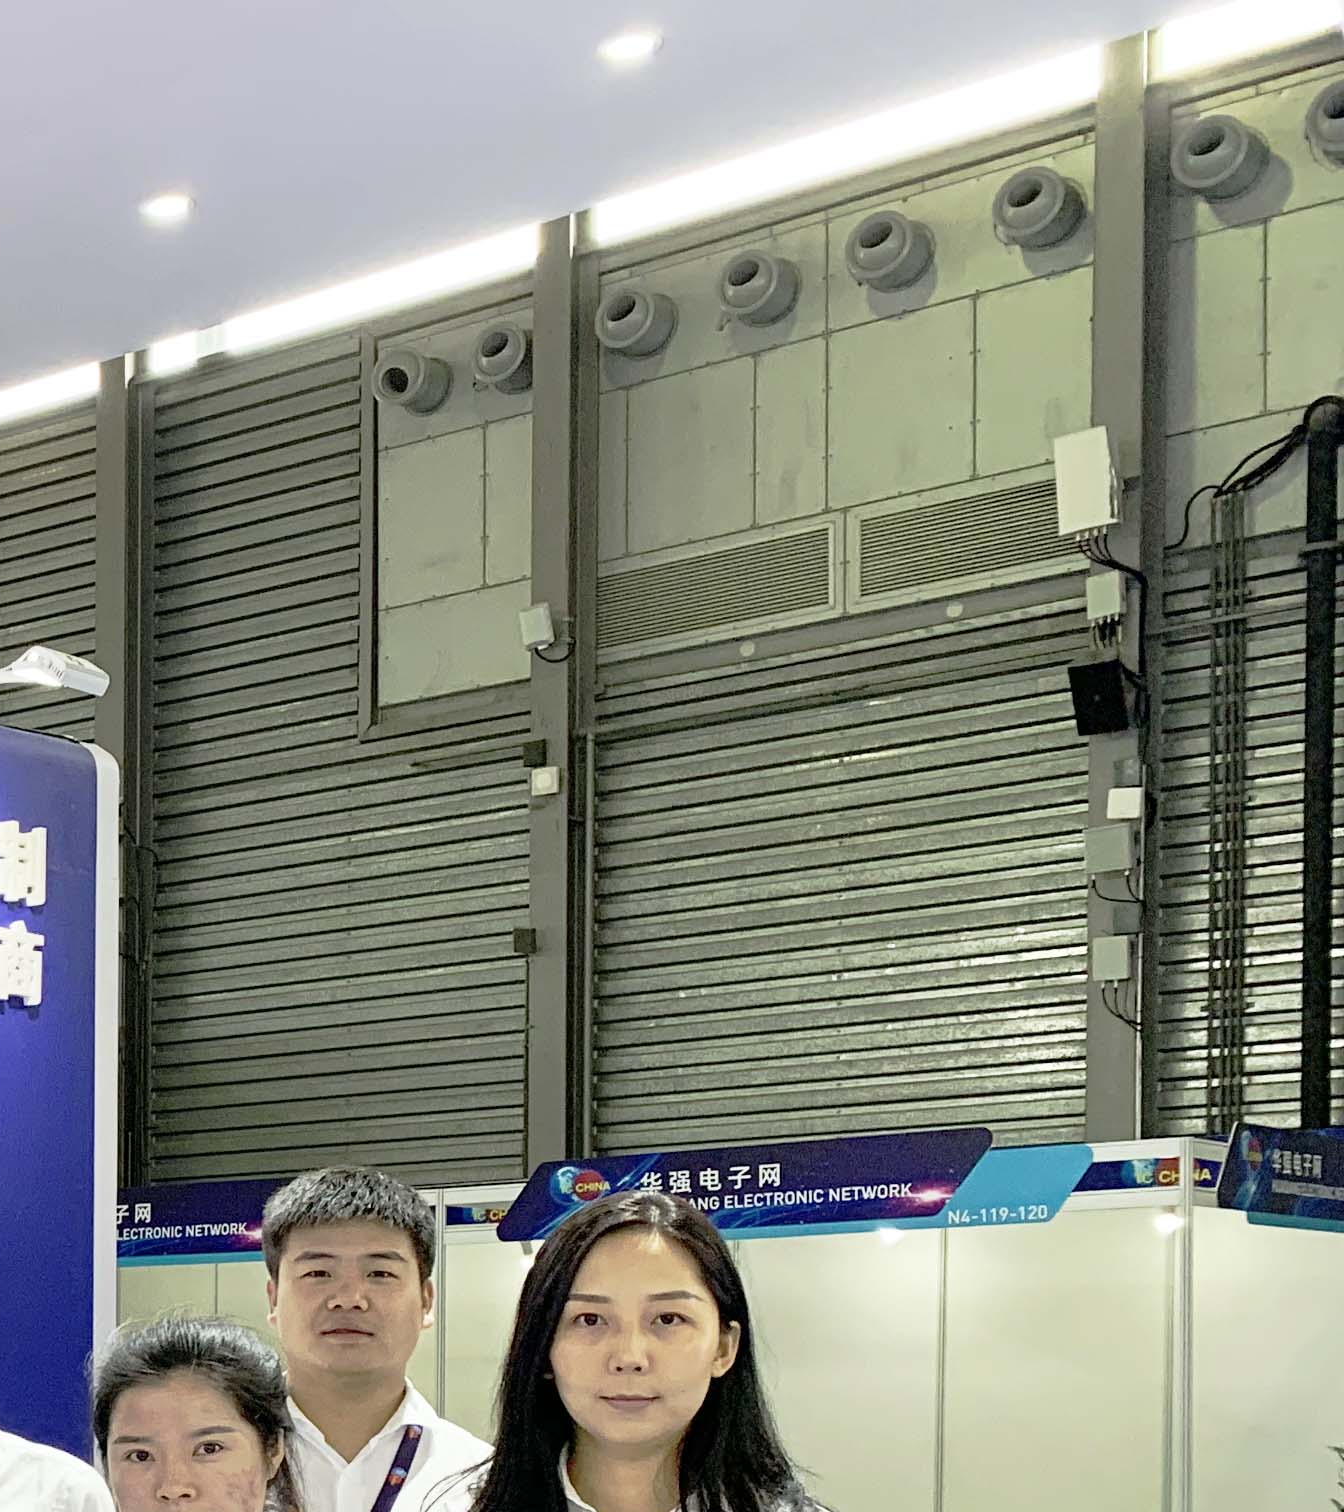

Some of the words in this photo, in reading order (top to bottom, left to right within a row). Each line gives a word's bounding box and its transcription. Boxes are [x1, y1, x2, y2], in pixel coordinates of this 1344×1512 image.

[640, 1163, 781, 1194] 华强电子网
[1158, 1168, 1211, 1183] CHNA
[575, 1182, 611, 1194] CHINA
[724, 1189, 824, 1210] ELECTRONIC
[829, 1182, 912, 1202] NETWORK
[948, 1205, 1048, 1225] N4-119-120
[185, 1222, 247, 1237] NETWORK
